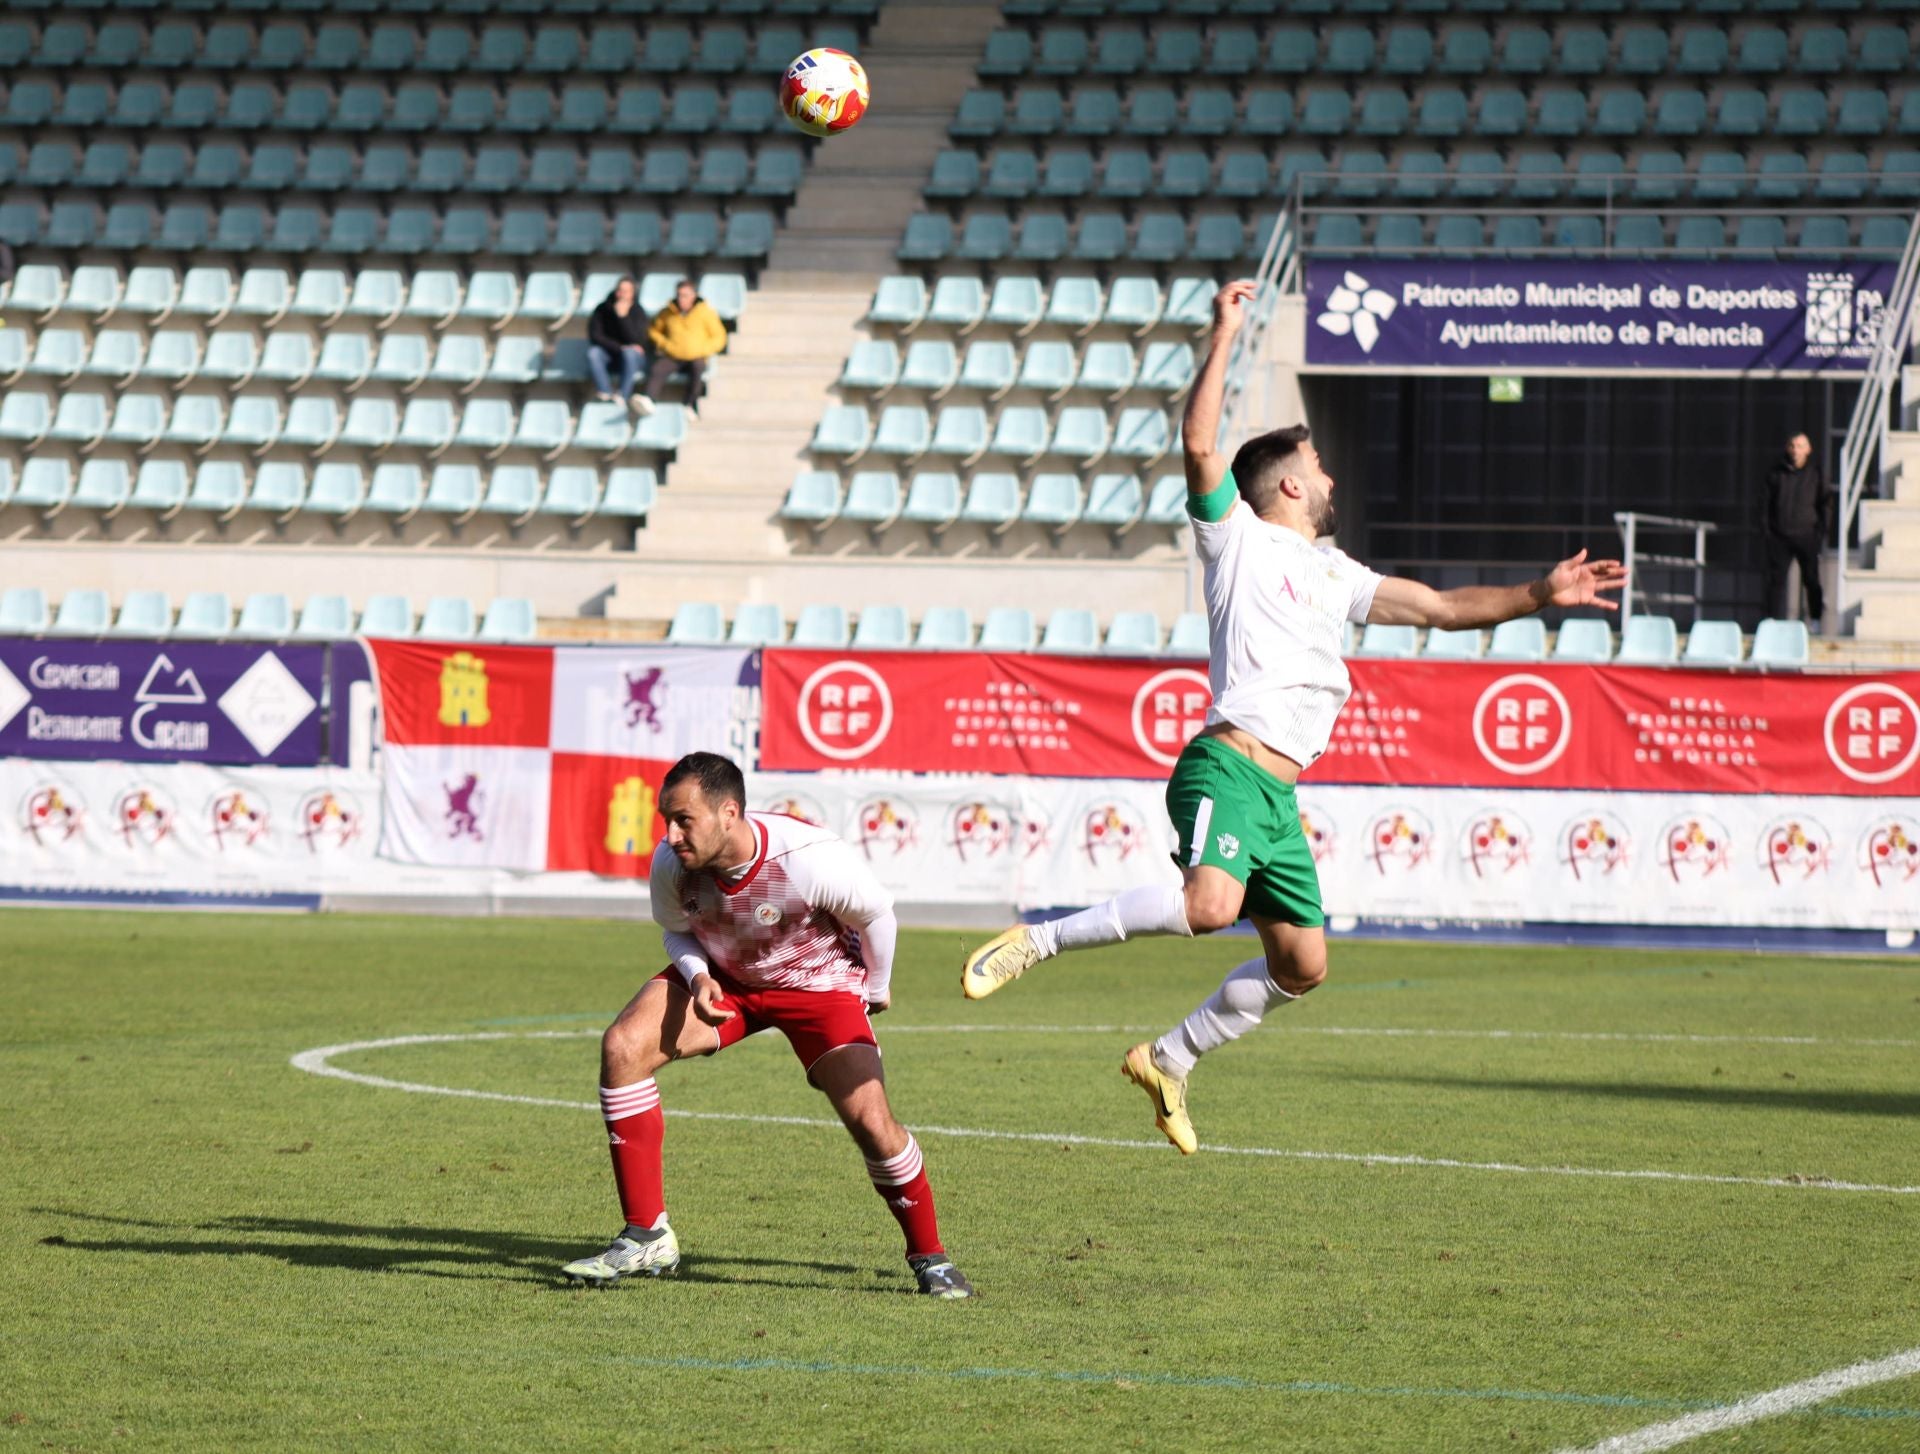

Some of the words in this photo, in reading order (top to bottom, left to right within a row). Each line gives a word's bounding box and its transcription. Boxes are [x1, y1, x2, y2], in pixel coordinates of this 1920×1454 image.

[1403, 282, 1520, 307] Patronato
[1525, 282, 1641, 313] Municipal
[1649, 284, 1681, 309] de
[1686, 285, 1797, 314] Deportes
[1440, 319, 1613, 349] Ayuntamiento
[1618, 320, 1650, 345] de
[1656, 321, 1764, 347] Palencia
[820, 684, 872, 709] RF
[985, 682, 1038, 697] REAL
[1351, 690, 1378, 705] AL
[1154, 691, 1206, 716] RF
[1339, 704, 1421, 722] RACIÓN
[1497, 698, 1549, 723] RF
[1669, 697, 1725, 713] REAL
[820, 711, 871, 735] EF
[955, 714, 1068, 732] ESPAÑOLA
[1626, 712, 1768, 731] FEDERACIÓN
[1848, 706, 1903, 731] RF
[951, 732, 979, 748] DE
[1335, 721, 1407, 740] AÑOLA
[1496, 725, 1548, 751] EF
[1638, 731, 1755, 748] ESPAÑOLA
[1634, 747, 1661, 763] DE
[1848, 734, 1902, 759] EF
